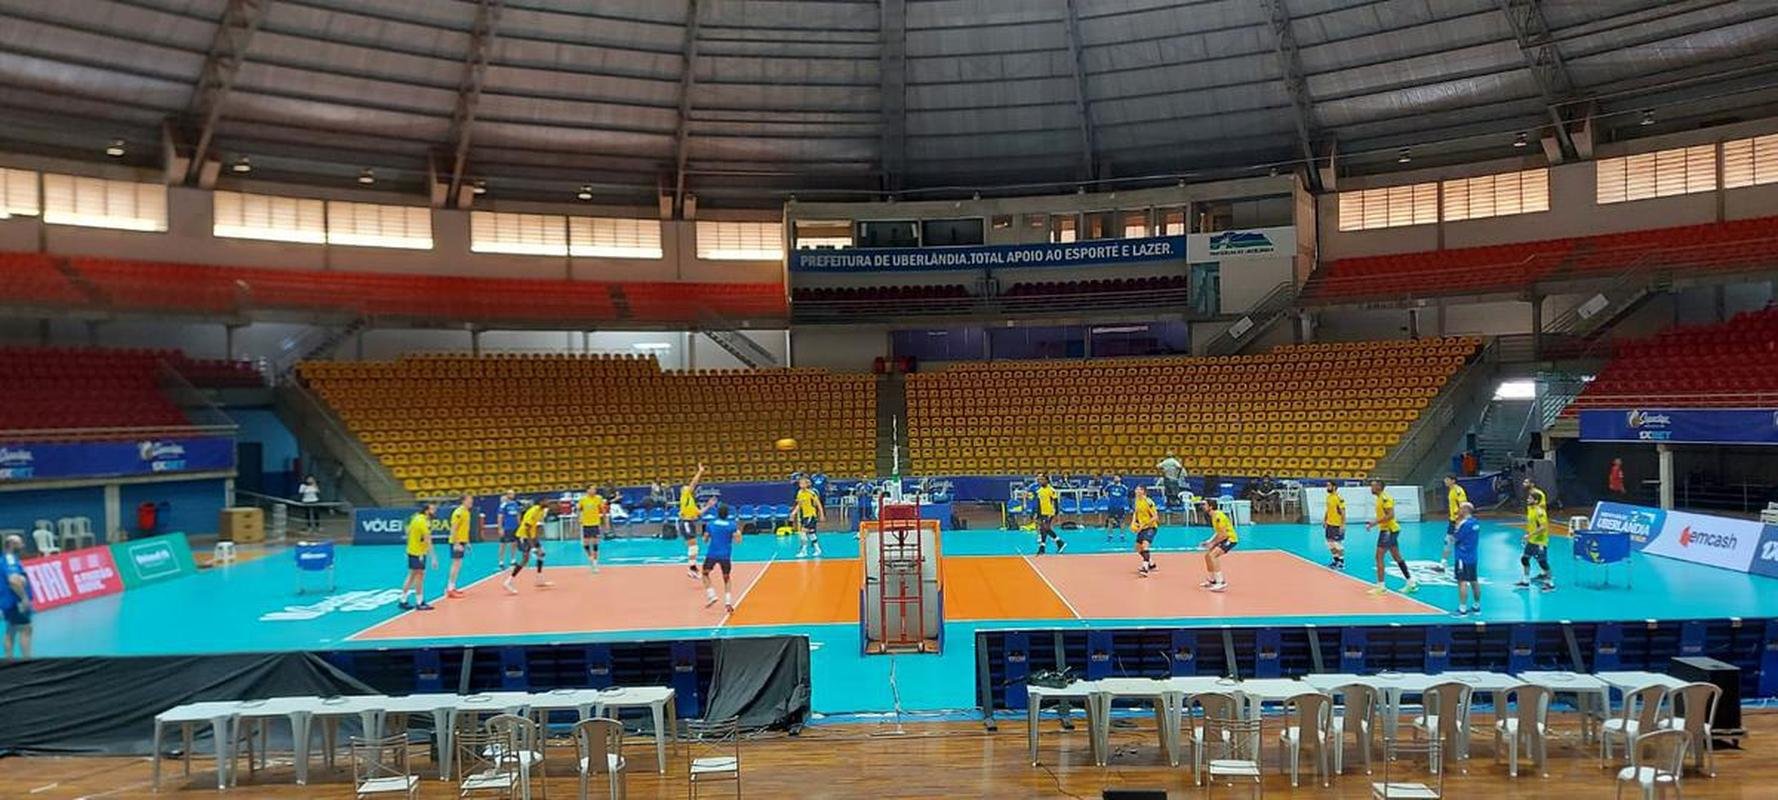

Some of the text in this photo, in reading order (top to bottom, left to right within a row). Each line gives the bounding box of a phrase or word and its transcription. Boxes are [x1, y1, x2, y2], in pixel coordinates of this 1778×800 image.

[801, 255, 872, 267] PREFEITURA
[875, 254, 891, 266] DE
[1007, 250, 1043, 263] APOIO
[1045, 249, 1062, 261] AO
[1122, 245, 1130, 257] E
[1133, 243, 1174, 257] LAZER.
[24, 560, 72, 603] FIAT
